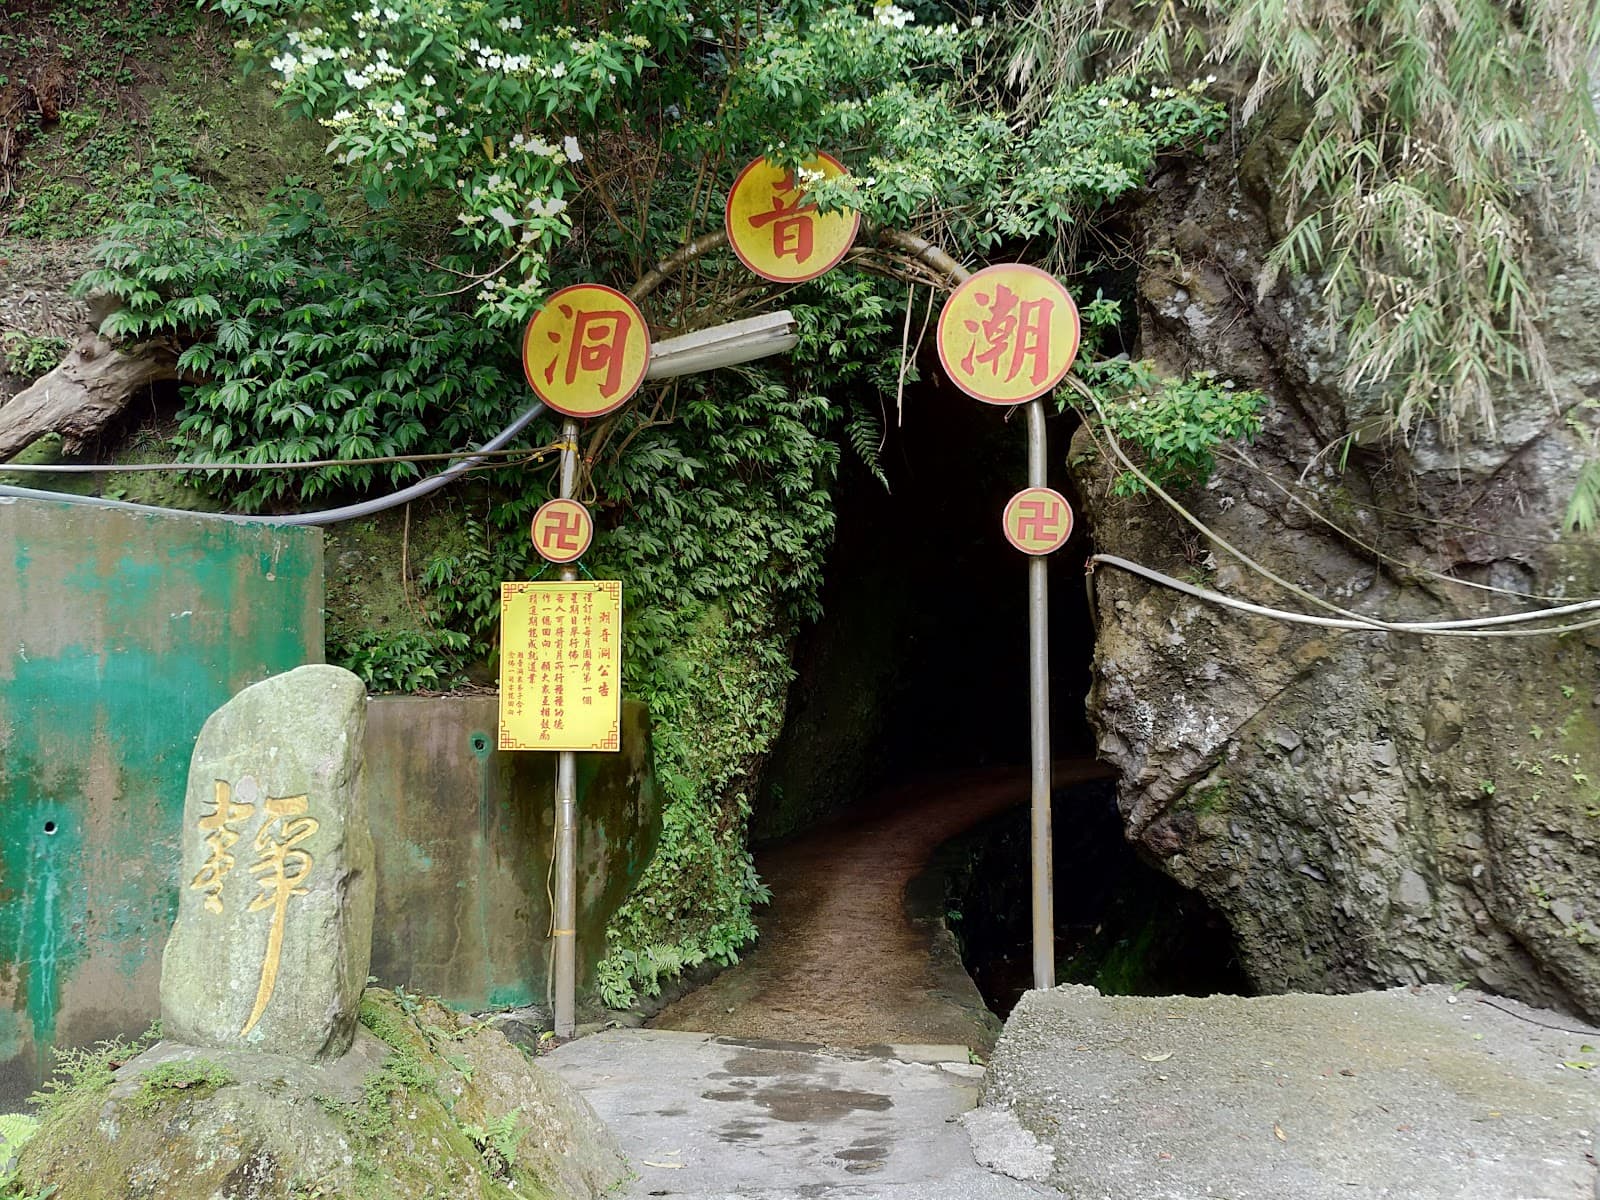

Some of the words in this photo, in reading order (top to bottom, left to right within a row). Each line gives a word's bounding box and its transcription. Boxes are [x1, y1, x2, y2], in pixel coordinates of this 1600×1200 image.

[545, 303, 631, 398] 洞
[961, 284, 1054, 389] 潮
[596, 611, 612, 697] 潮音洞公告
